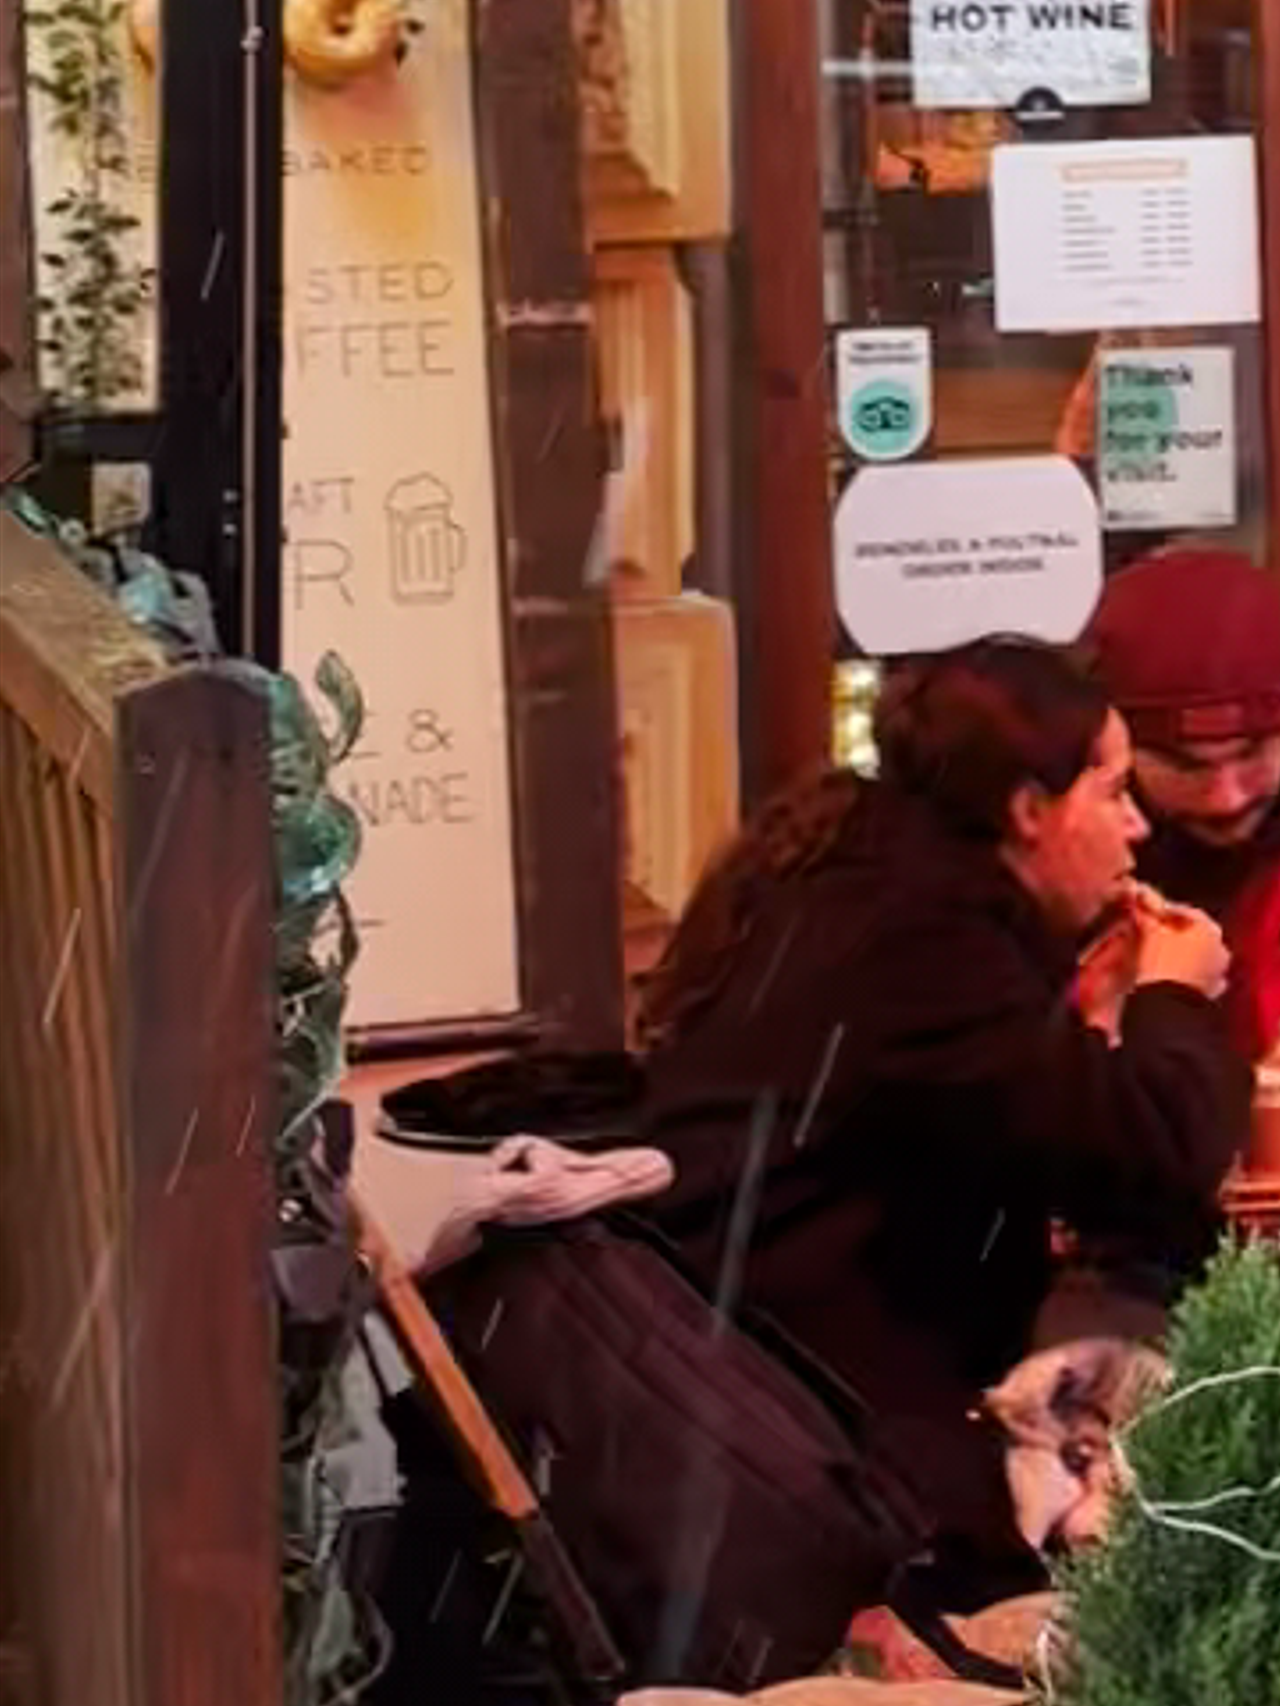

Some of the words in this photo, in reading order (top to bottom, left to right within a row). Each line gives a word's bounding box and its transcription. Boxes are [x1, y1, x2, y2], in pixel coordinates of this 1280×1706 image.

[931, 5, 1016, 32] HOT
[1028, 2, 1133, 31] WINE
[296, 319, 455, 378] FFEE
[404, 707, 454, 753] &
